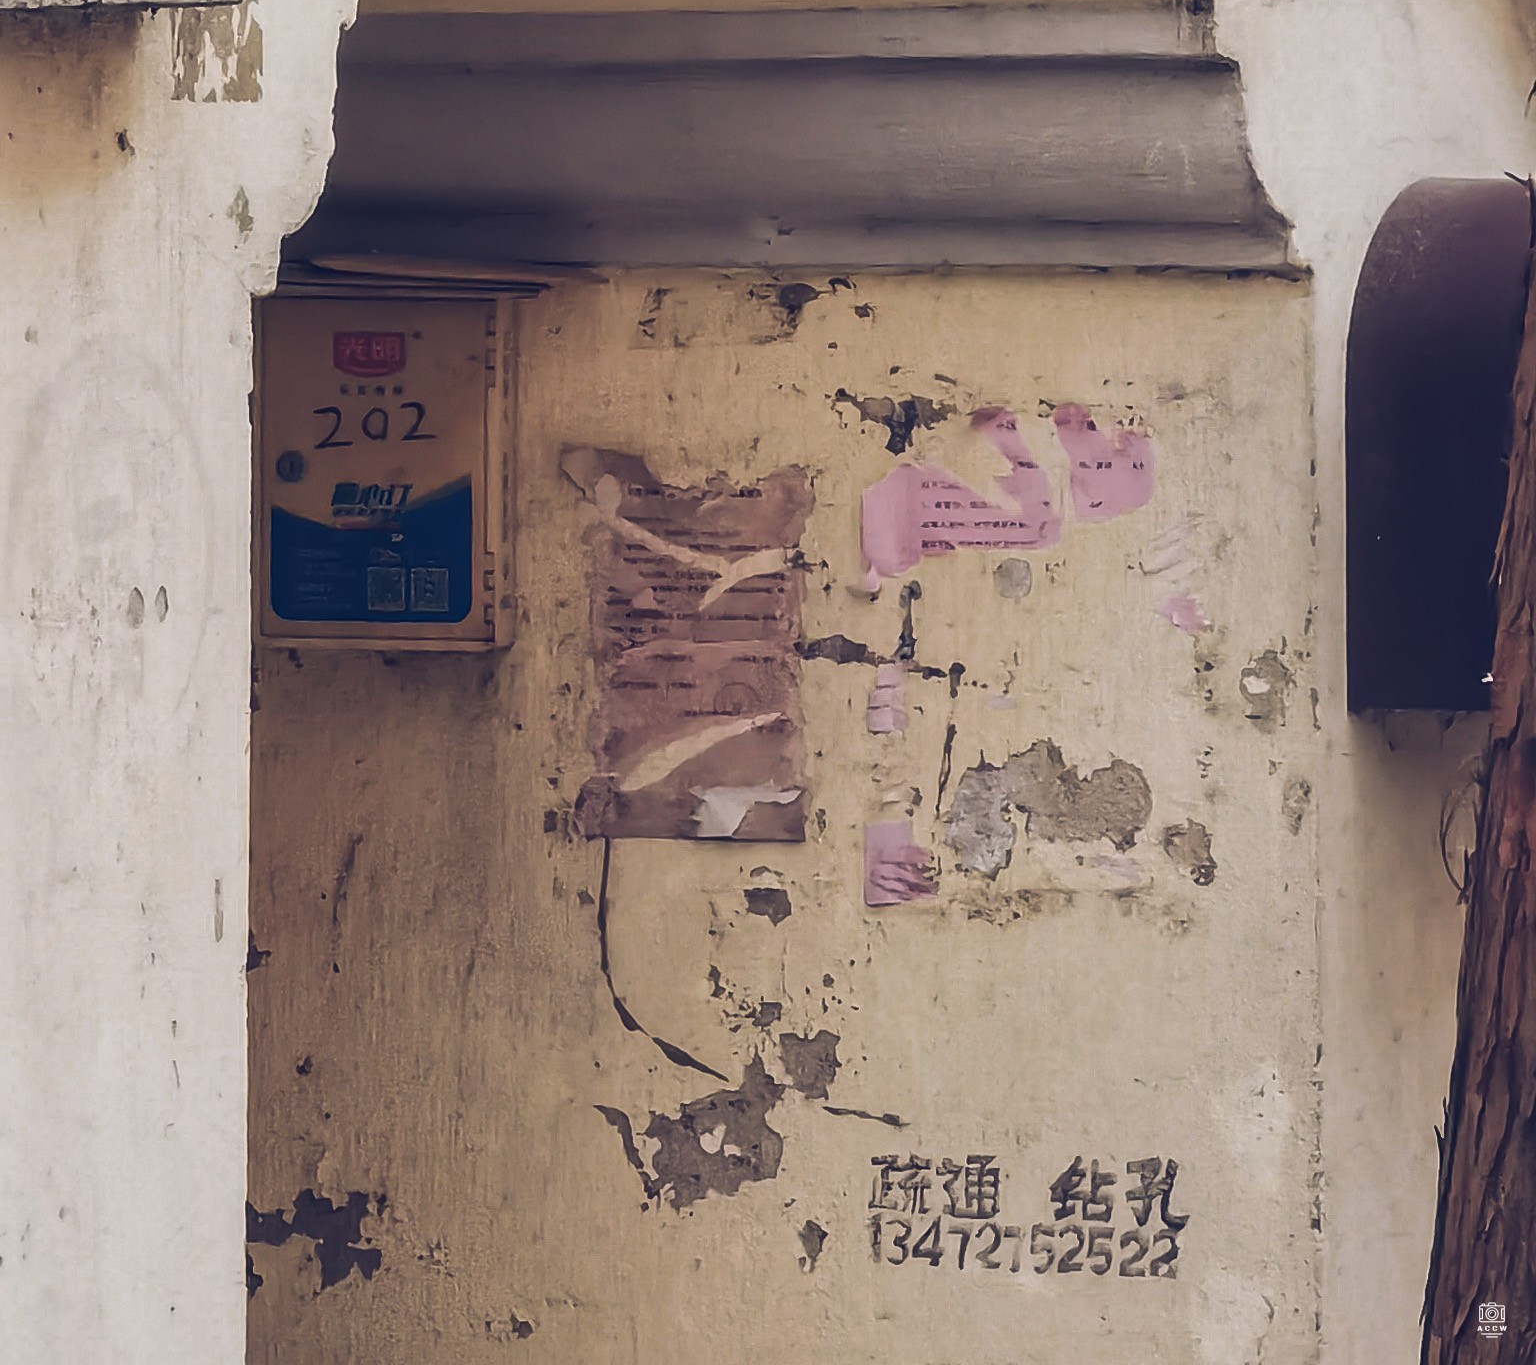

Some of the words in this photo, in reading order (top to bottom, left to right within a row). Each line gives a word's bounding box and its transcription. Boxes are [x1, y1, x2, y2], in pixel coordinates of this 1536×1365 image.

[312, 401, 438, 450] 202
[868, 1152, 1001, 1220] 疏通
[1048, 1155, 1191, 1231] 钻孔
